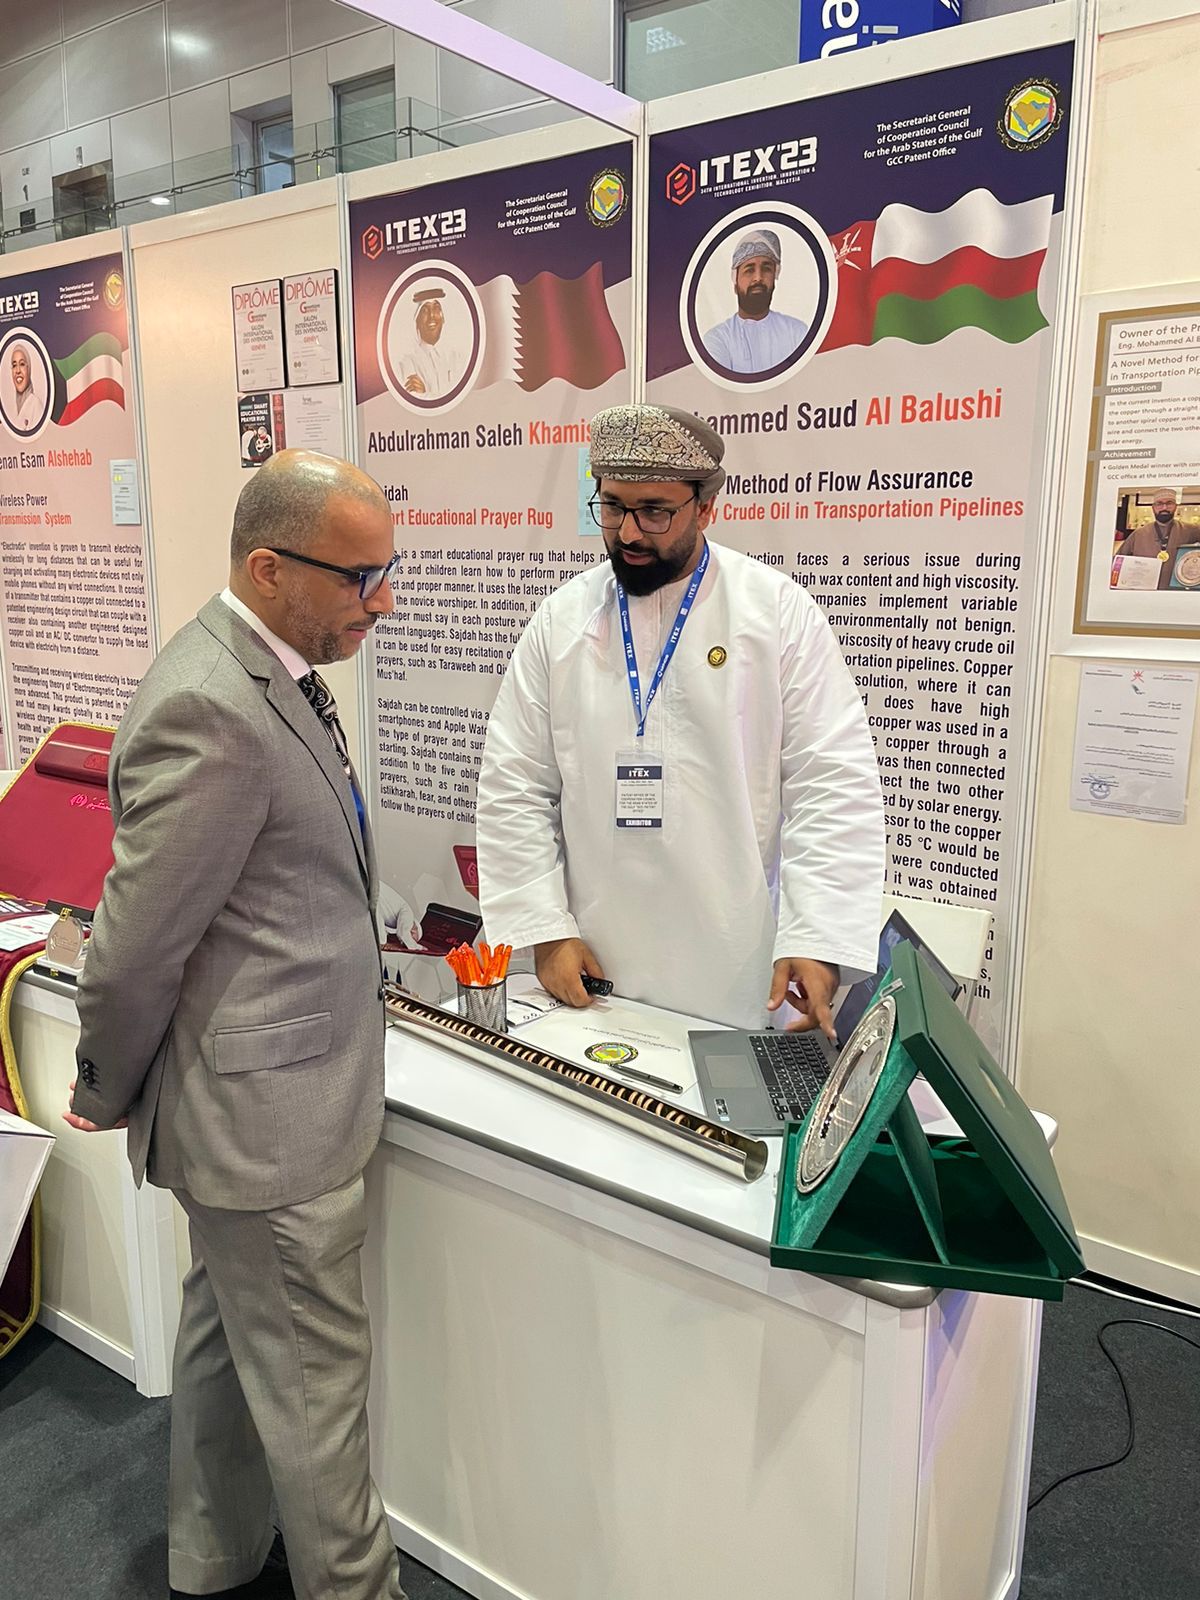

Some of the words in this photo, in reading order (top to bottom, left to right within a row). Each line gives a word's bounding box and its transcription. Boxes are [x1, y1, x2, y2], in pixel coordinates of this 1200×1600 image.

[876, 123, 890, 133] The
[892, 113, 936, 131] Secretariat
[938, 106, 971, 124] General
[876, 135, 886, 144] of
[886, 126, 936, 144] Cooperation
[936, 118, 970, 134] Council
[864, 150, 875, 160] for
[876, 146, 890, 156] the
[891, 142, 910, 154] Arab
[912, 138, 936, 150] States
[938, 134, 948, 144] of
[948, 132, 962, 142] the
[964, 126, 984, 140] Gulf
[700, 136, 818, 187] ITEX'23
[886, 156, 904, 166] GCC
[904, 151, 928, 164] Patent
[930, 146, 956, 160] Office
[714, 178, 750, 192] INTERNATIONAL
[780, 168, 809, 179] INNOVATION
[714, 186, 744, 198] TECHNOLOGY
[776, 176, 800, 186] MALAYSIA
[516, 194, 545, 206] Secretariat
[546, 189, 568, 200] General
[512, 204, 545, 217] Cooperation
[546, 199, 568, 209] Council
[386, 208, 467, 246] ITEX'23
[513, 227, 525, 236] GCC
[525, 225, 543, 234] Patent
[544, 221, 560, 230] Office
[235, 287, 279, 310] DIPLÔME
[286, 277, 334, 301] DIPLÔME
[295, 321, 326, 329] INTERNATIONAL
[1120, 329, 1153, 339] Owner
[1156, 326, 1168, 335] of
[1170, 325, 1187, 334] the
[1137, 338, 1183, 348] Mohammed
[1121, 358, 1145, 368] Novel
[1148, 356, 1183, 365] Method
[1121, 368, 1185, 380] Transportation
[1110, 384, 1156, 393] Introduction
[694, 404, 788, 435] ammed
[797, 400, 857, 431] Saud
[866, 396, 890, 427] Al
[901, 387, 1002, 424] Balushi
[368, 428, 470, 454] Abdulrahman
[476, 422, 522, 448] Saleh
[20, 452, 45, 468] Esam
[48, 449, 92, 467] Alshehab
[1104, 450, 1151, 458] Achievement
[726, 472, 788, 495] Method
[795, 472, 812, 493] of
[818, 470, 861, 493] Flow
[867, 468, 974, 492] Assurance
[26, 494, 47, 506] Power
[723, 500, 765, 522] Crude
[770, 500, 790, 520] Oil
[795, 501, 809, 520] in
[814, 498, 933, 523] Transportation
[940, 496, 1024, 520] Pipelines
[45, 512, 72, 527] System
[408, 508, 477, 526] Educational
[481, 508, 523, 528] Prayer
[528, 508, 553, 529] Rug
[60, 544, 78, 552] proven
[89, 544, 111, 553] transmit
[114, 544, 142, 555] electricity
[401, 550, 408, 560] is
[412, 552, 417, 560] a
[420, 550, 443, 560] smart
[447, 549, 493, 561] educational
[498, 551, 524, 564] prayer
[529, 552, 544, 563] rug
[548, 550, 566, 562] that
[570, 550, 595, 564] helps
[797, 552, 828, 566] faces
[842, 555, 850, 566] a
[864, 552, 910, 566] serious
[925, 552, 960, 566] issue
[976, 552, 1020, 570] during
[408, 565, 422, 575] and
[425, 564, 457, 576] children
[461, 565, 482, 577] learn
[486, 566, 503, 578] how
[508, 567, 516, 578] to
[520, 566, 555, 580] perform
[792, 572, 816, 588] high
[820, 574, 843, 586] wax
[846, 574, 892, 588] content
[896, 573, 920, 588] and
[922, 573, 951, 591] high
[955, 574, 1019, 592] viscosity.
[688, 583, 697, 598] ITEX
[879, 594, 948, 610] implement
[961, 596, 1018, 612] variable
[670, 627, 680, 643] ITEX
[828, 614, 928, 631] environmentally
[936, 617, 958, 631] not
[965, 617, 1016, 636] benign.
[838, 633, 892, 650] viscosity
[896, 635, 908, 650] of
[912, 636, 950, 654] heavy
[954, 640, 993, 654] crude
[998, 640, 1014, 655] oil
[896, 656, 960, 673] pipelines.
[964, 659, 1013, 677] Copper
[855, 674, 908, 692] solution,
[918, 678, 958, 694] where
[968, 680, 977, 695] it
[986, 684, 1012, 698] can
[916, 720, 941, 732] was
[946, 722, 978, 736] used
[983, 724, 995, 738] in
[1000, 729, 1008, 740] a
[917, 798, 950, 815] solar
[954, 804, 1002, 822] energy.
[896, 833, 912, 848] 85
[918, 836, 932, 851] °C
[938, 840, 976, 858] would
[984, 846, 1000, 862] be
